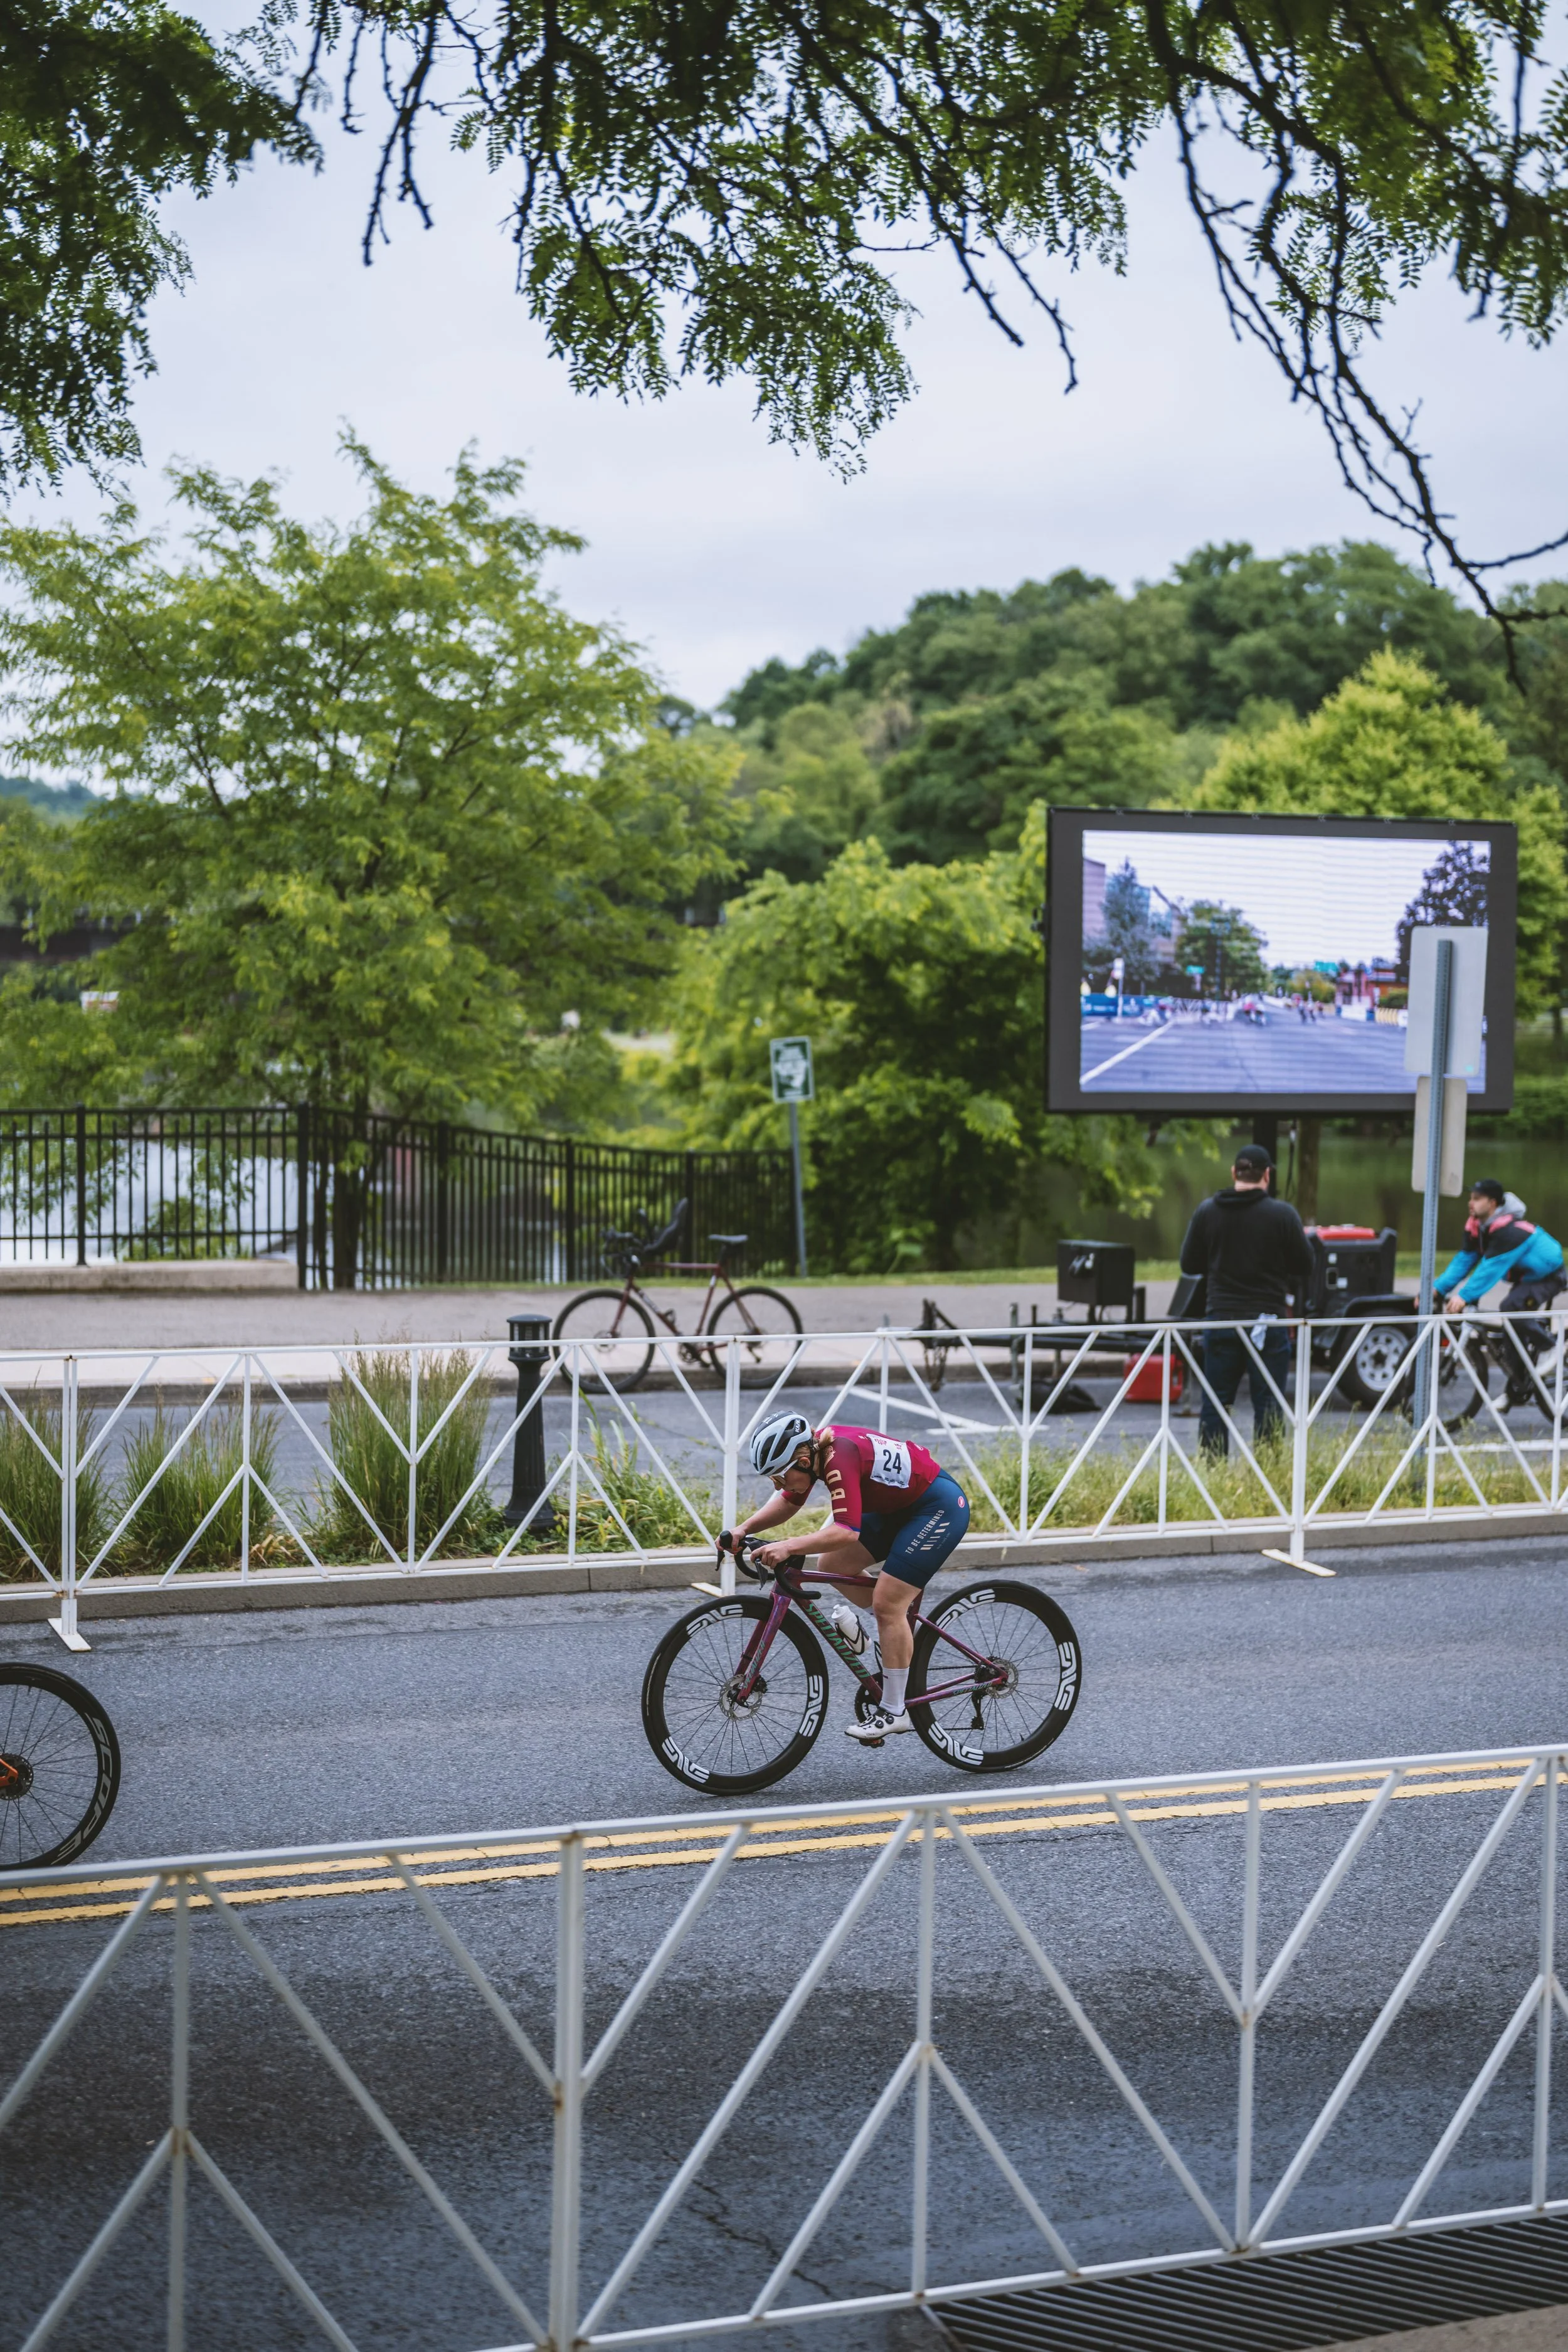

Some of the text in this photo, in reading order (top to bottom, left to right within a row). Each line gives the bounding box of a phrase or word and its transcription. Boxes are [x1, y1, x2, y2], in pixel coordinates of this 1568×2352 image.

[882, 1449, 903, 1475] 24
[904, 1546, 914, 1554] TO
[911, 1539, 921, 1547] BE
[917, 1510, 945, 1540] DETERMINED
[686, 1604, 744, 1638] ENVE
[936, 1589, 996, 1631] ENVE
[805, 1603, 871, 1678] SPECIALIZED
[1054, 1641, 1077, 1711] ENVE
[799, 1675, 824, 1737] ENVE
[662, 1735, 710, 1784] ENVE
[928, 1720, 984, 1766] ENVE
[50, 1712, 113, 1865] SCOPE
